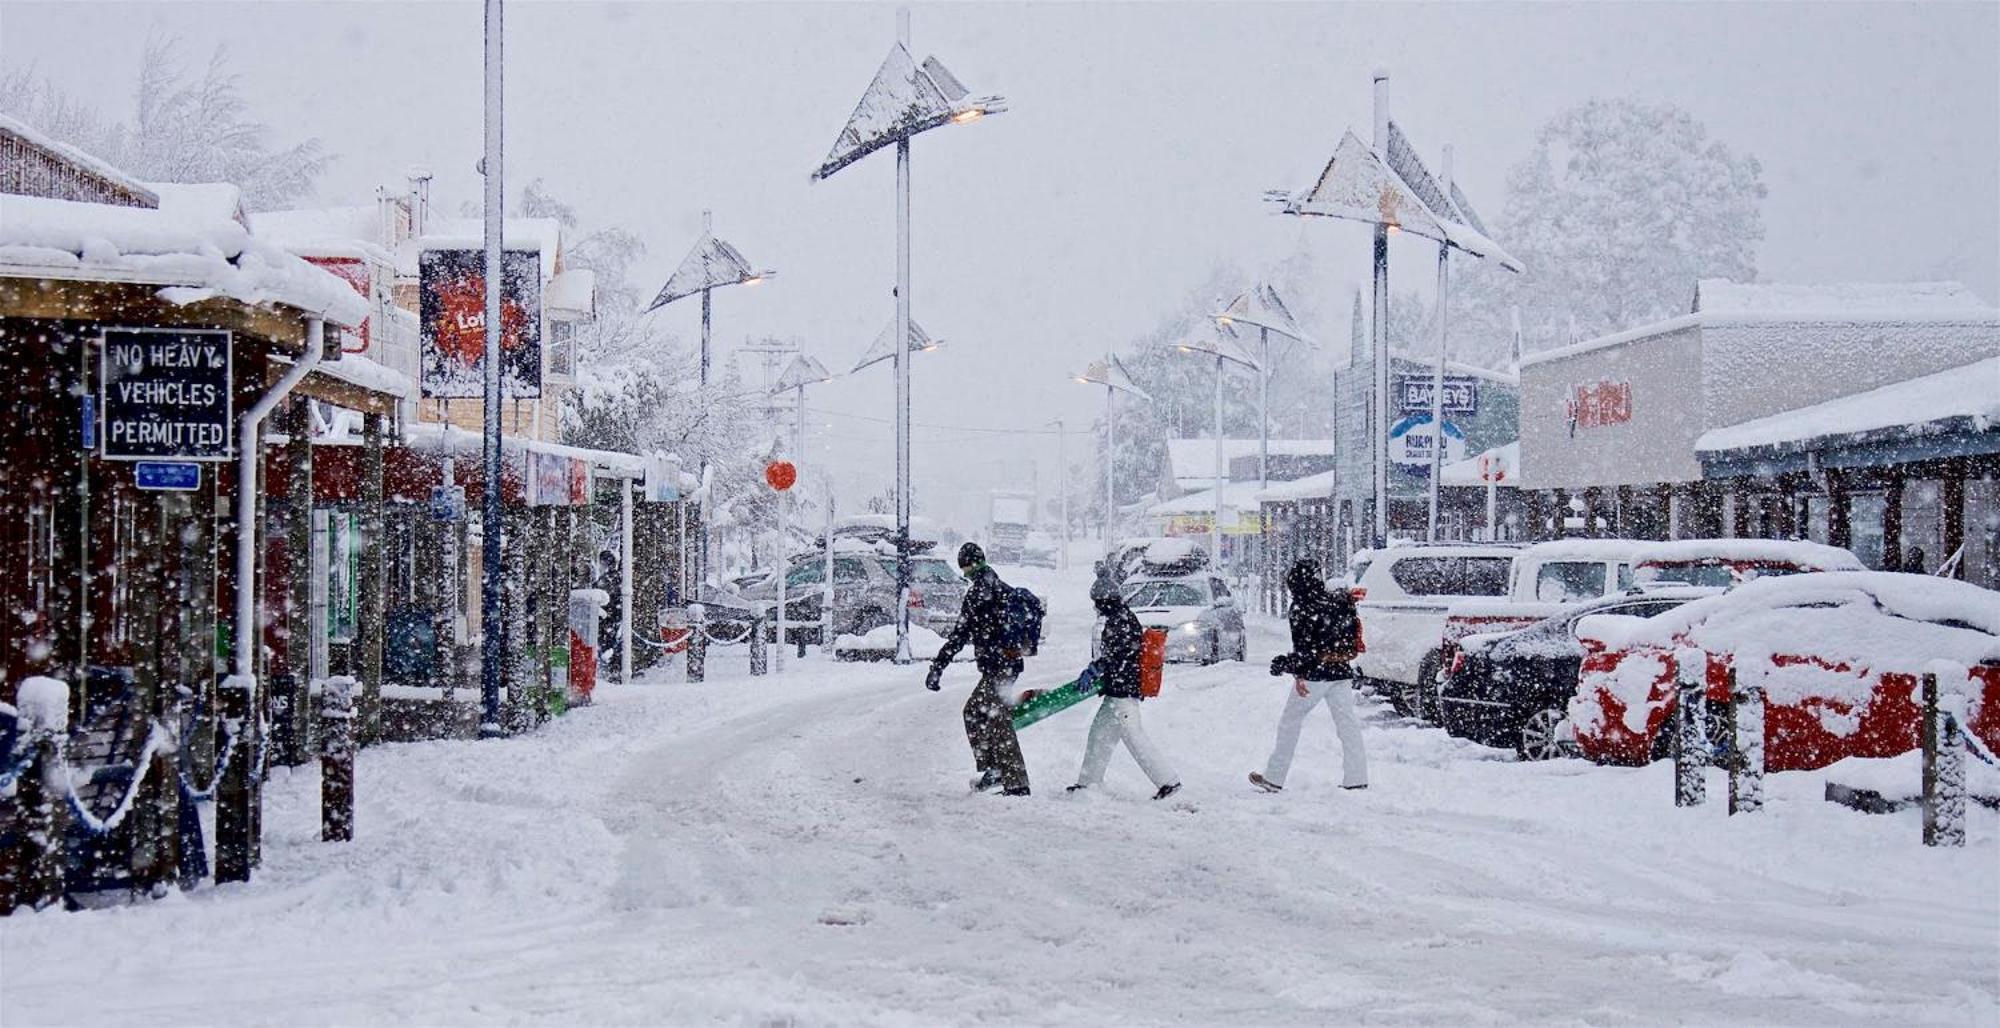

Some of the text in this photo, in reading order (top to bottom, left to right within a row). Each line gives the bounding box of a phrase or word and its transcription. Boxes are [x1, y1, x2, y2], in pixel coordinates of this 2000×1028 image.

[115, 344, 217, 367] NO HEAVY
[119, 382, 216, 405] VEHICLES
[1408, 385, 1470, 405] BAYEYS
[112, 422, 223, 444] PERMITTED
